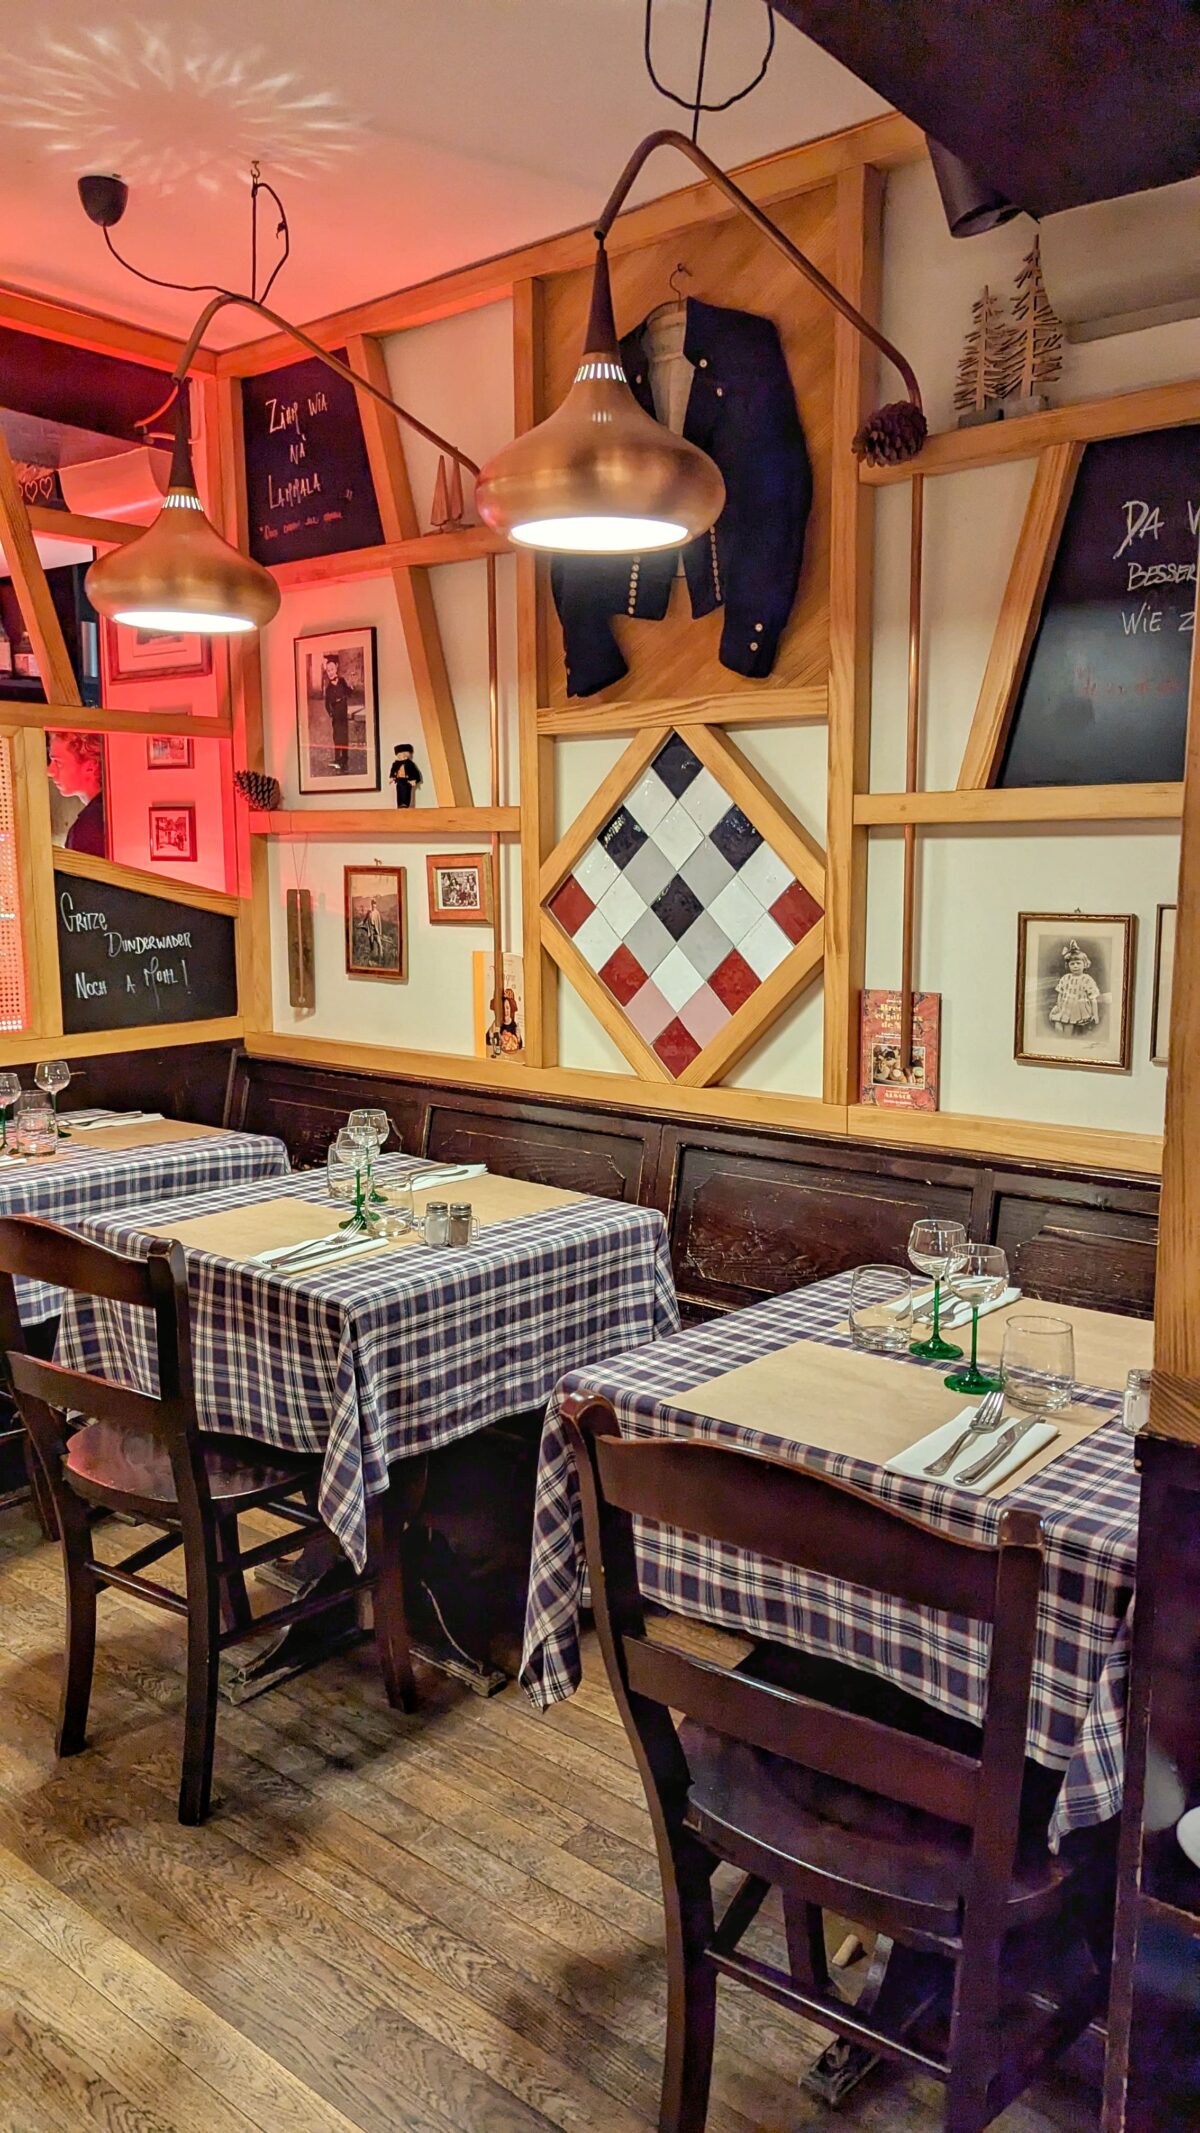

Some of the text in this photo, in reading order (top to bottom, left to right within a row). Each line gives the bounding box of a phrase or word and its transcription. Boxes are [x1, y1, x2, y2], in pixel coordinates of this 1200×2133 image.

[1112, 499, 1165, 560] DA
[1127, 561, 1198, 592] BESSER
[126, 974, 136, 994] A
